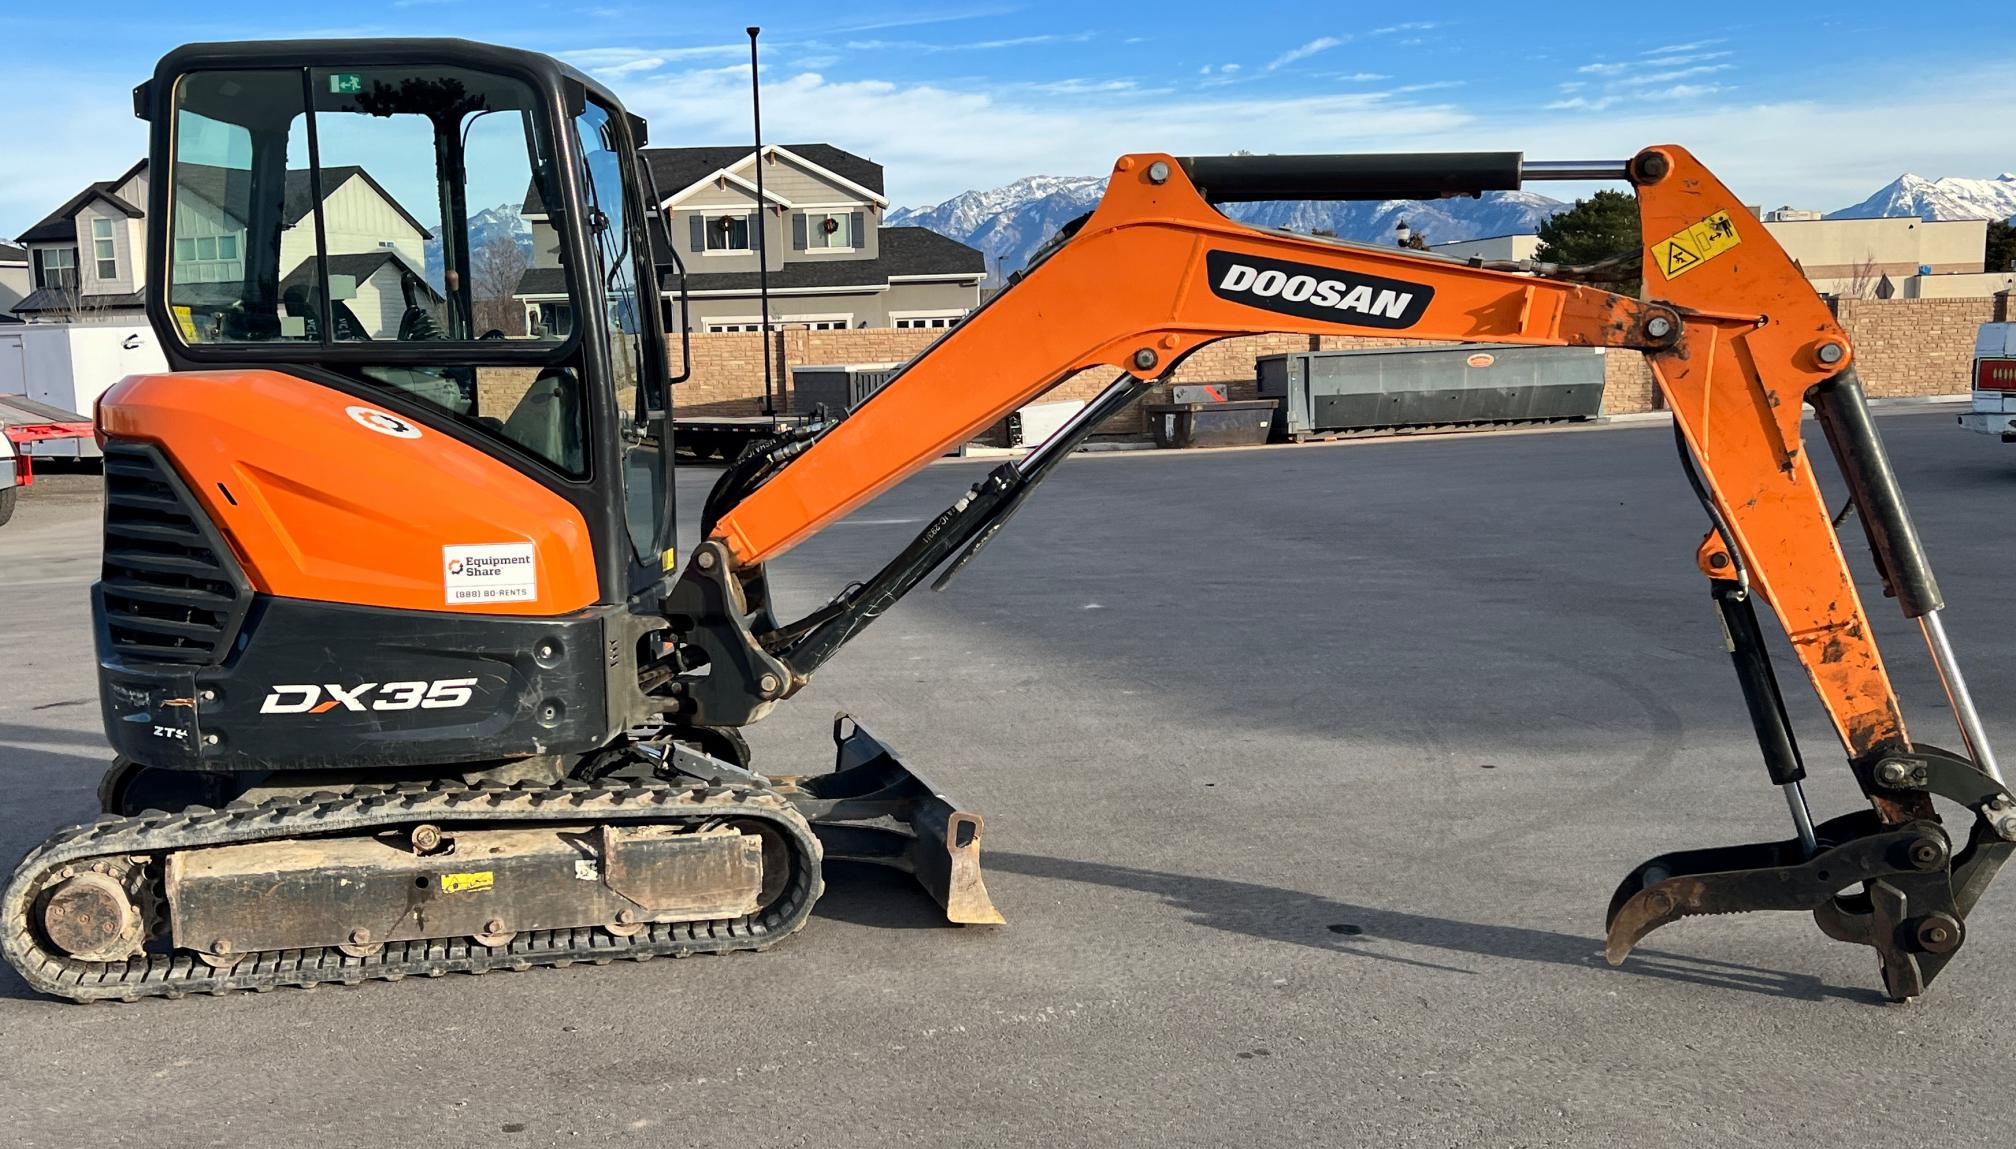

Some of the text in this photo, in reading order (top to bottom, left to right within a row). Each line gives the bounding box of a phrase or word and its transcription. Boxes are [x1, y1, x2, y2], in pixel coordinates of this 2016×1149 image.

[1219, 263, 1413, 320] DOOSAN
[465, 555, 531, 568] Equipment
[466, 567, 502, 577] Share
[455, 590, 481, 599] (888)
[259, 677, 479, 714] DX35
